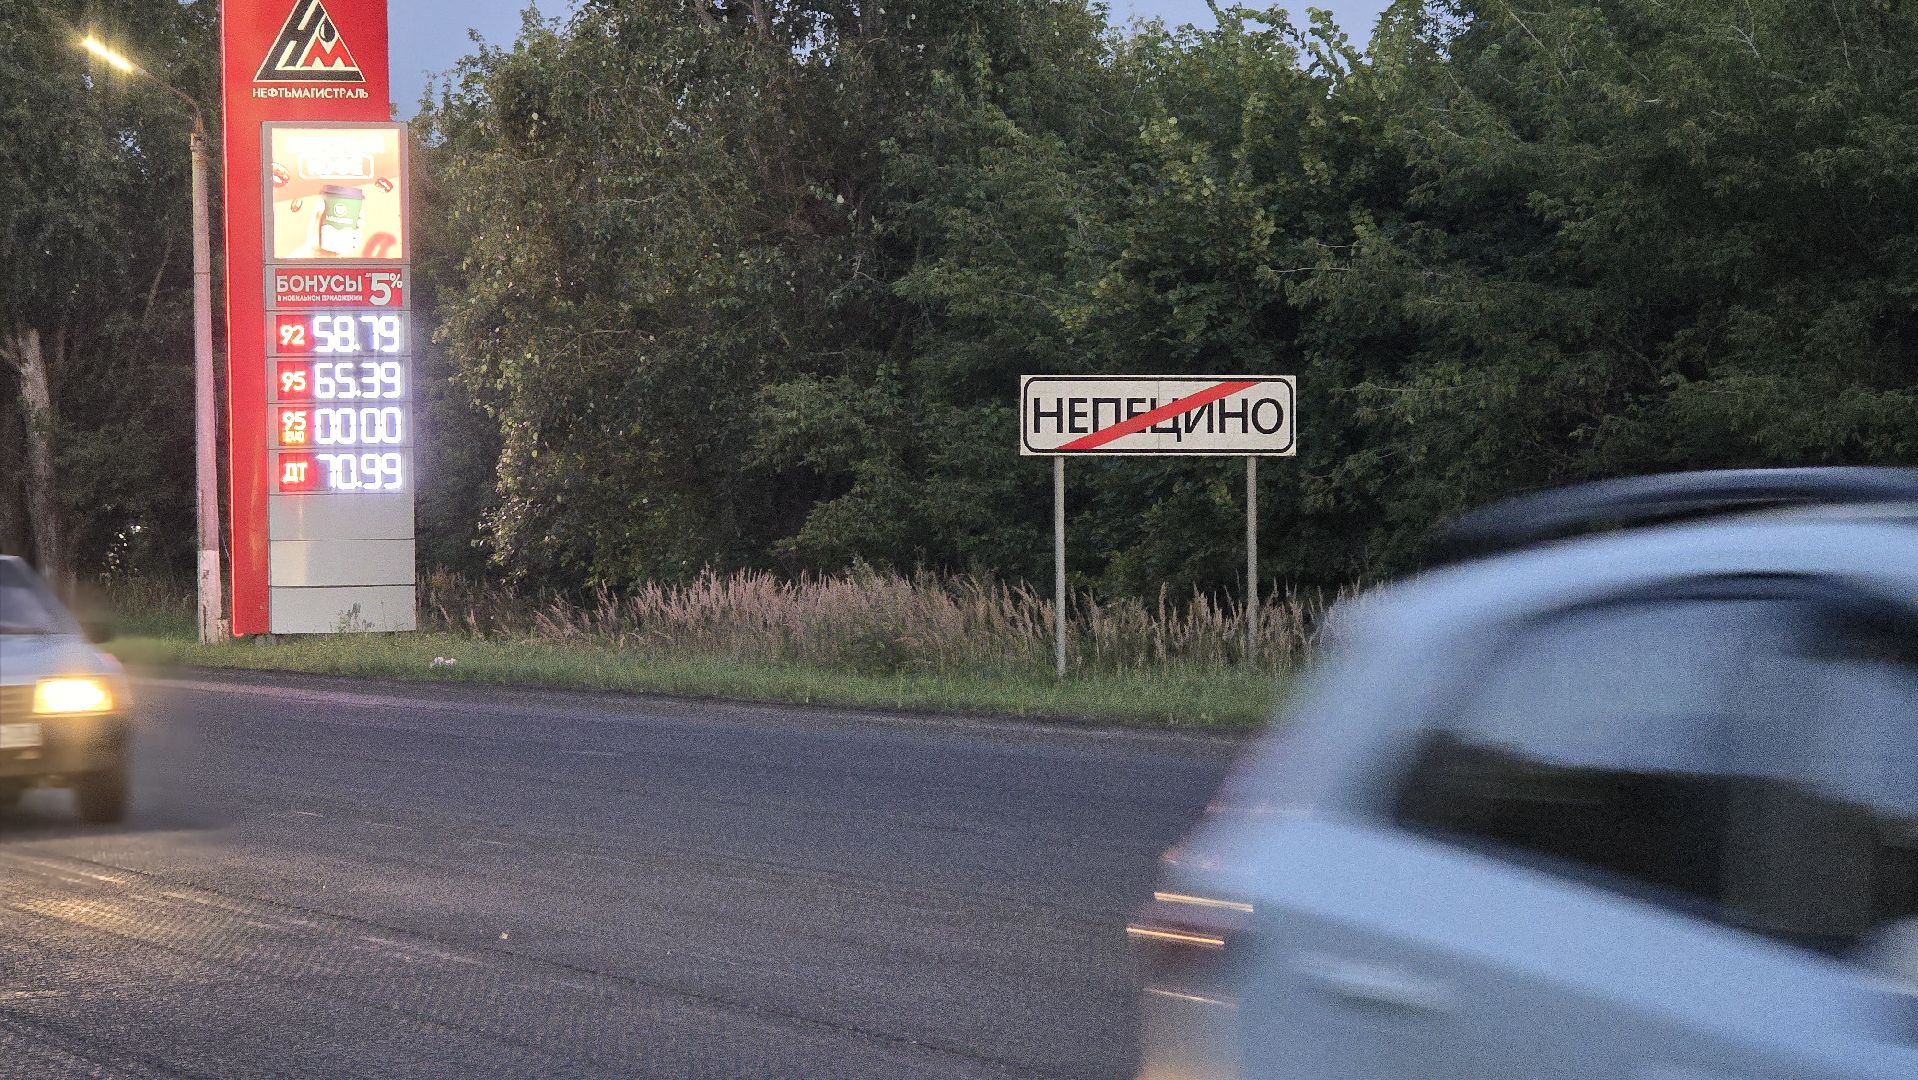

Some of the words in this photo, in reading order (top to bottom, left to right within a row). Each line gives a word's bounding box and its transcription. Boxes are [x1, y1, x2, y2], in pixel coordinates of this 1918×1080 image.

[252, 87, 369, 99] НЕФТЬМАГИСТРАЛЬ
[276, 274, 363, 293] БОНУСЫ
[279, 324, 305, 346] 92
[312, 315, 400, 353] 58.79
[281, 371, 307, 393] 95
[314, 361, 401, 399] 65.39
[281, 410, 307, 431] 95
[1033, 397, 1285, 442] НЕПЕЦИНО
[282, 461, 308, 483] ДТ
[315, 452, 402, 490] 70.99
